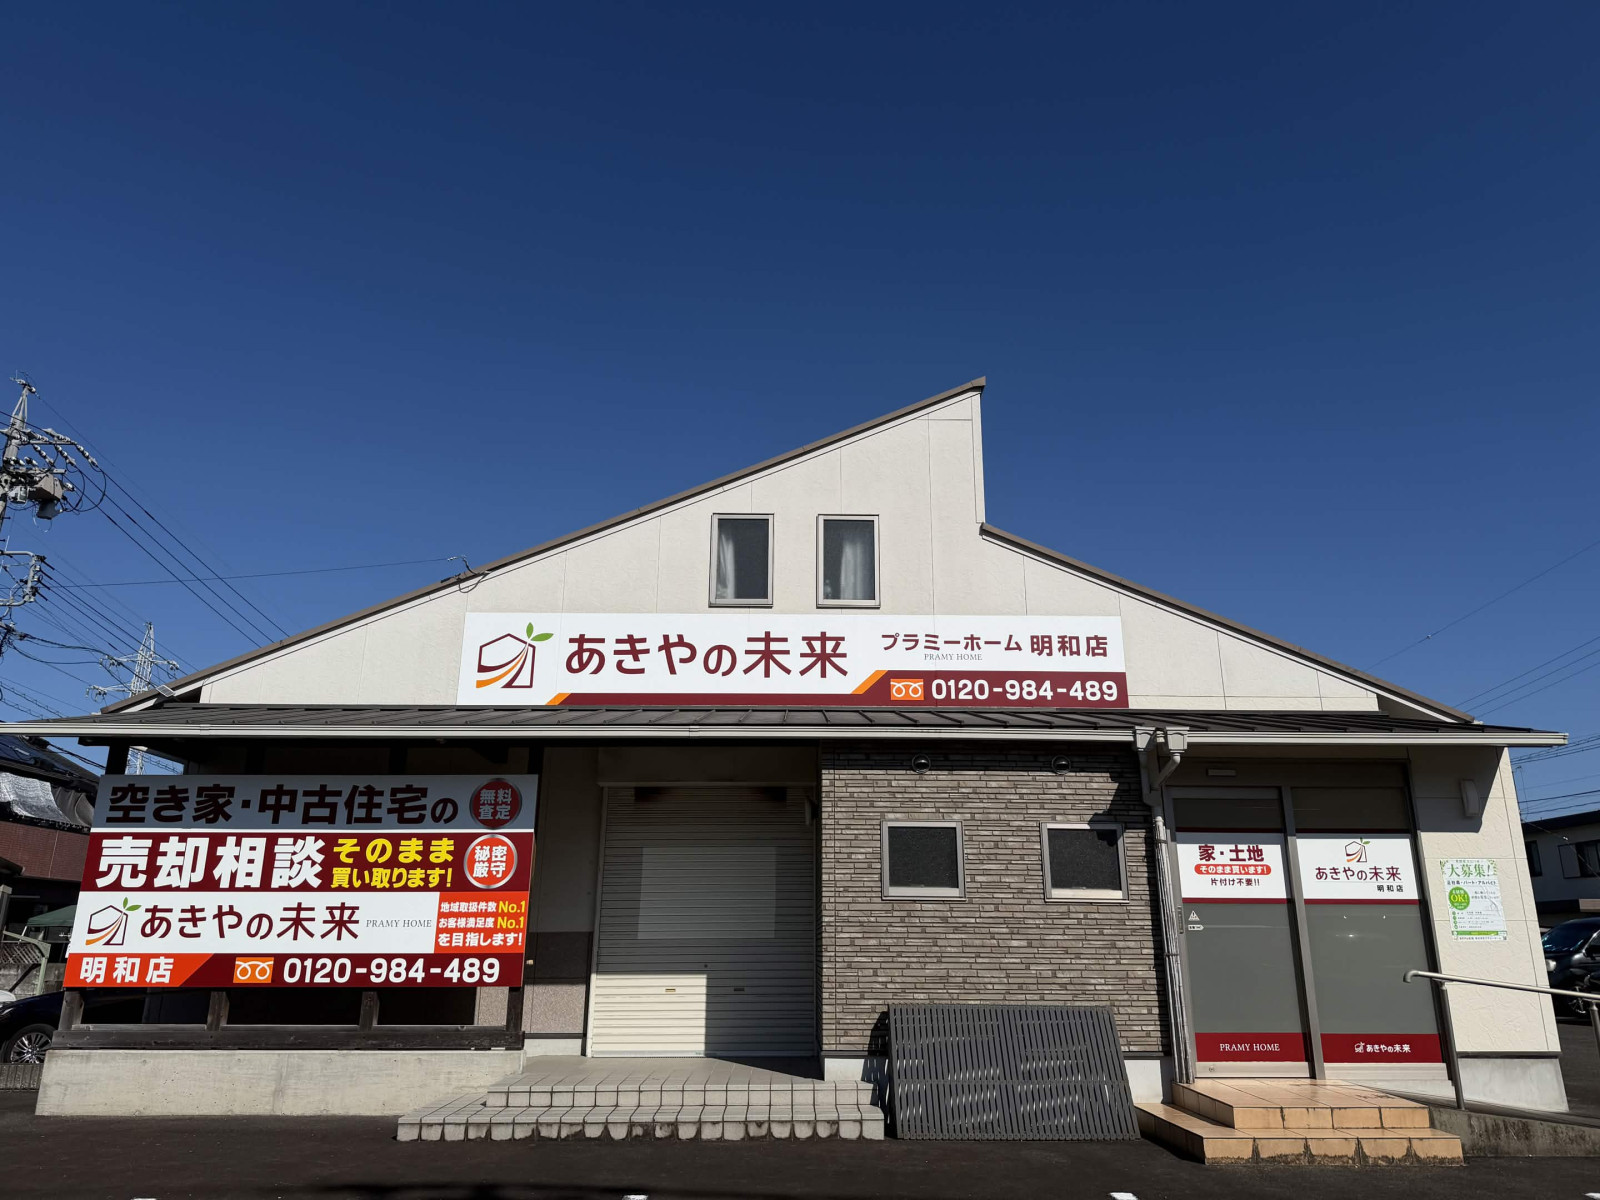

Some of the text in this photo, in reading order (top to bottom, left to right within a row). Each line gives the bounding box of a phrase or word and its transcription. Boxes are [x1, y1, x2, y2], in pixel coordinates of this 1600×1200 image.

[881, 632, 1108, 657] プラミーホーム 明和店
[565, 631, 848, 678] あきやの未来
[924, 653, 982, 661] PRAMY HOME
[931, 679, 1118, 701] 0120-984-489
[106, 783, 459, 825] 空き家・中古住宅の
[480, 788, 512, 804] 無料
[478, 804, 511, 820] 査定
[333, 837, 455, 864] そのまま
[474, 845, 507, 862] 秘密
[1198, 844, 1265, 862] 家・土地
[95, 836, 326, 888] 売却相談
[472, 861, 506, 878] 厳守
[1200, 865, 1268, 874] そのまま買います!
[330, 867, 453, 889] 買い取ります!
[1315, 866, 1402, 882] あきやの未来
[1376, 884, 1404, 893] 明和店
[440, 900, 526, 913] 地域取扱件数 No.1
[140, 902, 360, 941] あきやの未来
[365, 919, 432, 928] PRAMY HOME
[438, 916, 524, 929] お客様満足度 No.1
[438, 932, 522, 947] を目指します!
[79, 956, 175, 984] 明和店
[283, 957, 500, 983] 0120-984-489
[1219, 1043, 1281, 1052] PRAMY HOME
[1366, 1043, 1412, 1053] あきやの未来
